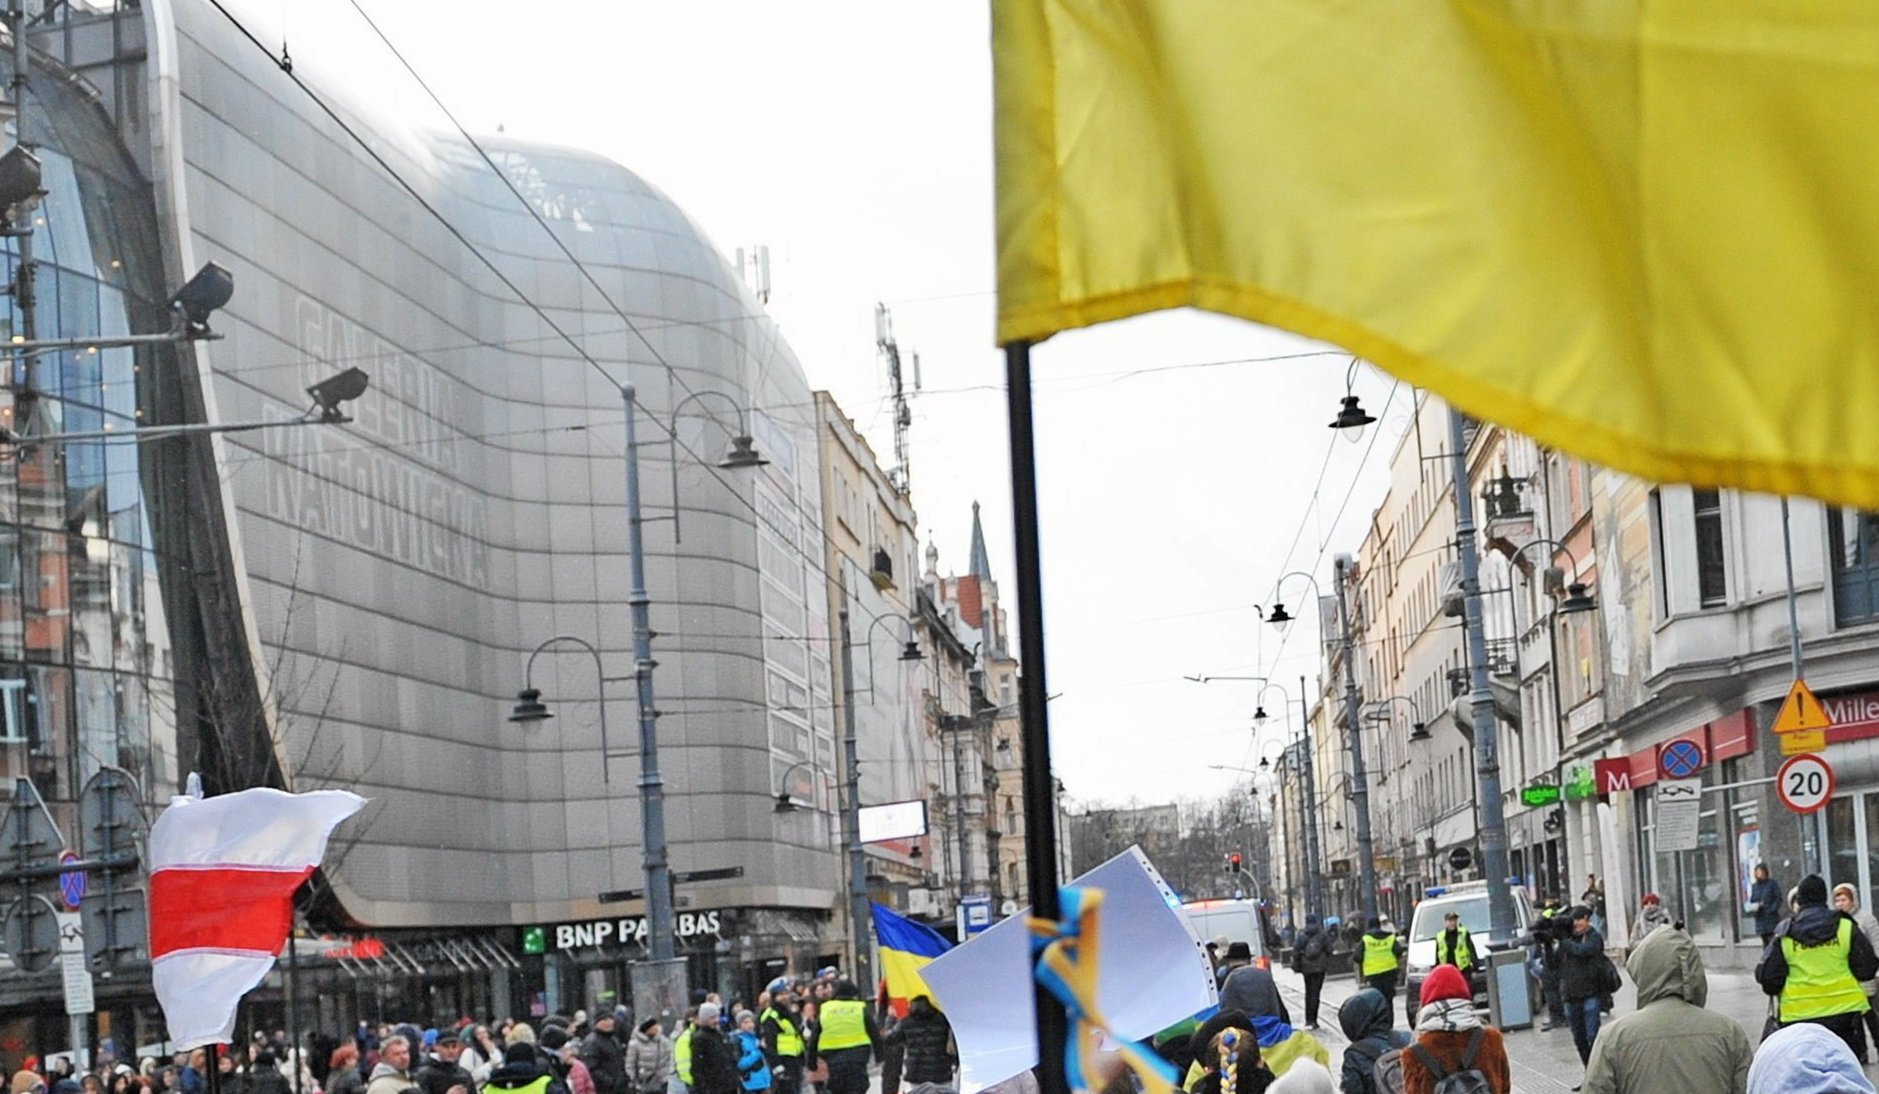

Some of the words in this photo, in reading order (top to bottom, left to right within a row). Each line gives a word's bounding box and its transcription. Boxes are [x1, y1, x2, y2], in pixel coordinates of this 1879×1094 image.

[1789, 772, 1823, 796] 20
[556, 919, 613, 949] BNP
[619, 910, 720, 943] PABAS
